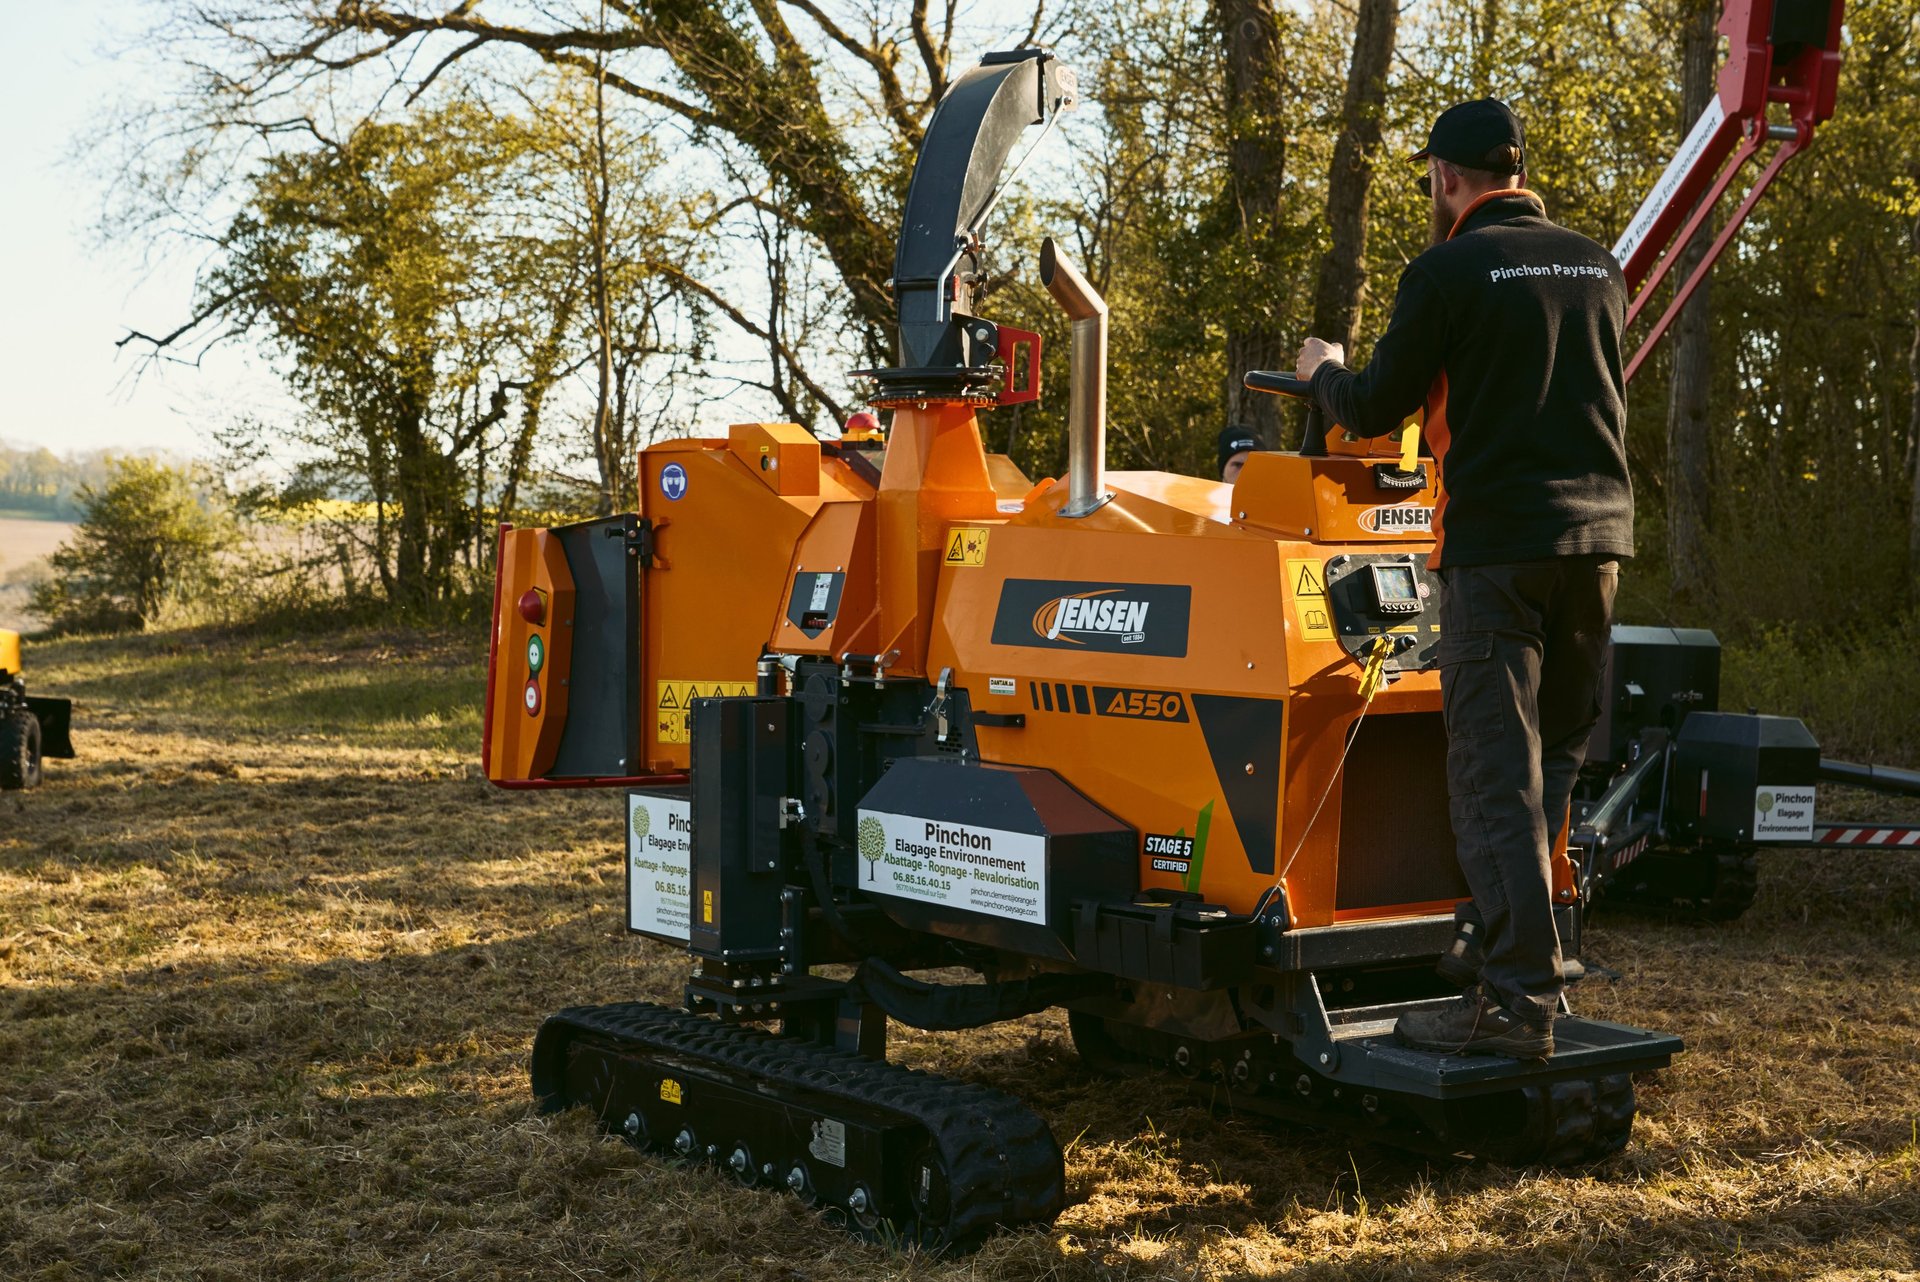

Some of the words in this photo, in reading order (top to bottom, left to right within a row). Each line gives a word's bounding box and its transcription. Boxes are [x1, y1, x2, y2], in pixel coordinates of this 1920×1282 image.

[1635, 199, 1663, 239] Elagage
[1662, 116, 1717, 199] Environnement
[1490, 264, 1551, 282] Pinchon
[1552, 263, 1608, 279] Paysage
[1373, 508, 1436, 531] JENSEN
[1047, 598, 1149, 640] JENSEN
[1106, 691, 1181, 718] A550
[1775, 793, 1813, 804] Pinchon
[1777, 809, 1804, 819] Elagage
[925, 822, 991, 851] Pinchon
[1758, 824, 1810, 833] Environnement
[648, 834, 676, 851] Elagage
[1145, 836, 1182, 855] STAGE
[1183, 840, 1192, 856] 5
[895, 838, 937, 859] Elagage
[940, 846, 1026, 872] Environnement
[634, 857, 658, 873] Abattage
[662, 861, 687, 877] Rognage
[884, 853, 922, 871] Abattage
[929, 860, 967, 880] Rognage
[973, 867, 1039, 891] Revalorisation
[1153, 859, 1188, 872] CERTIFIED
[655, 880, 690, 897] 06.85.16.
[893, 871, 951, 891] 06.85.16.40.15
[970, 887, 1037, 906] pinchon.clement@orange.fr
[970, 899, 1038, 917] www.pinchon-paysage.com
